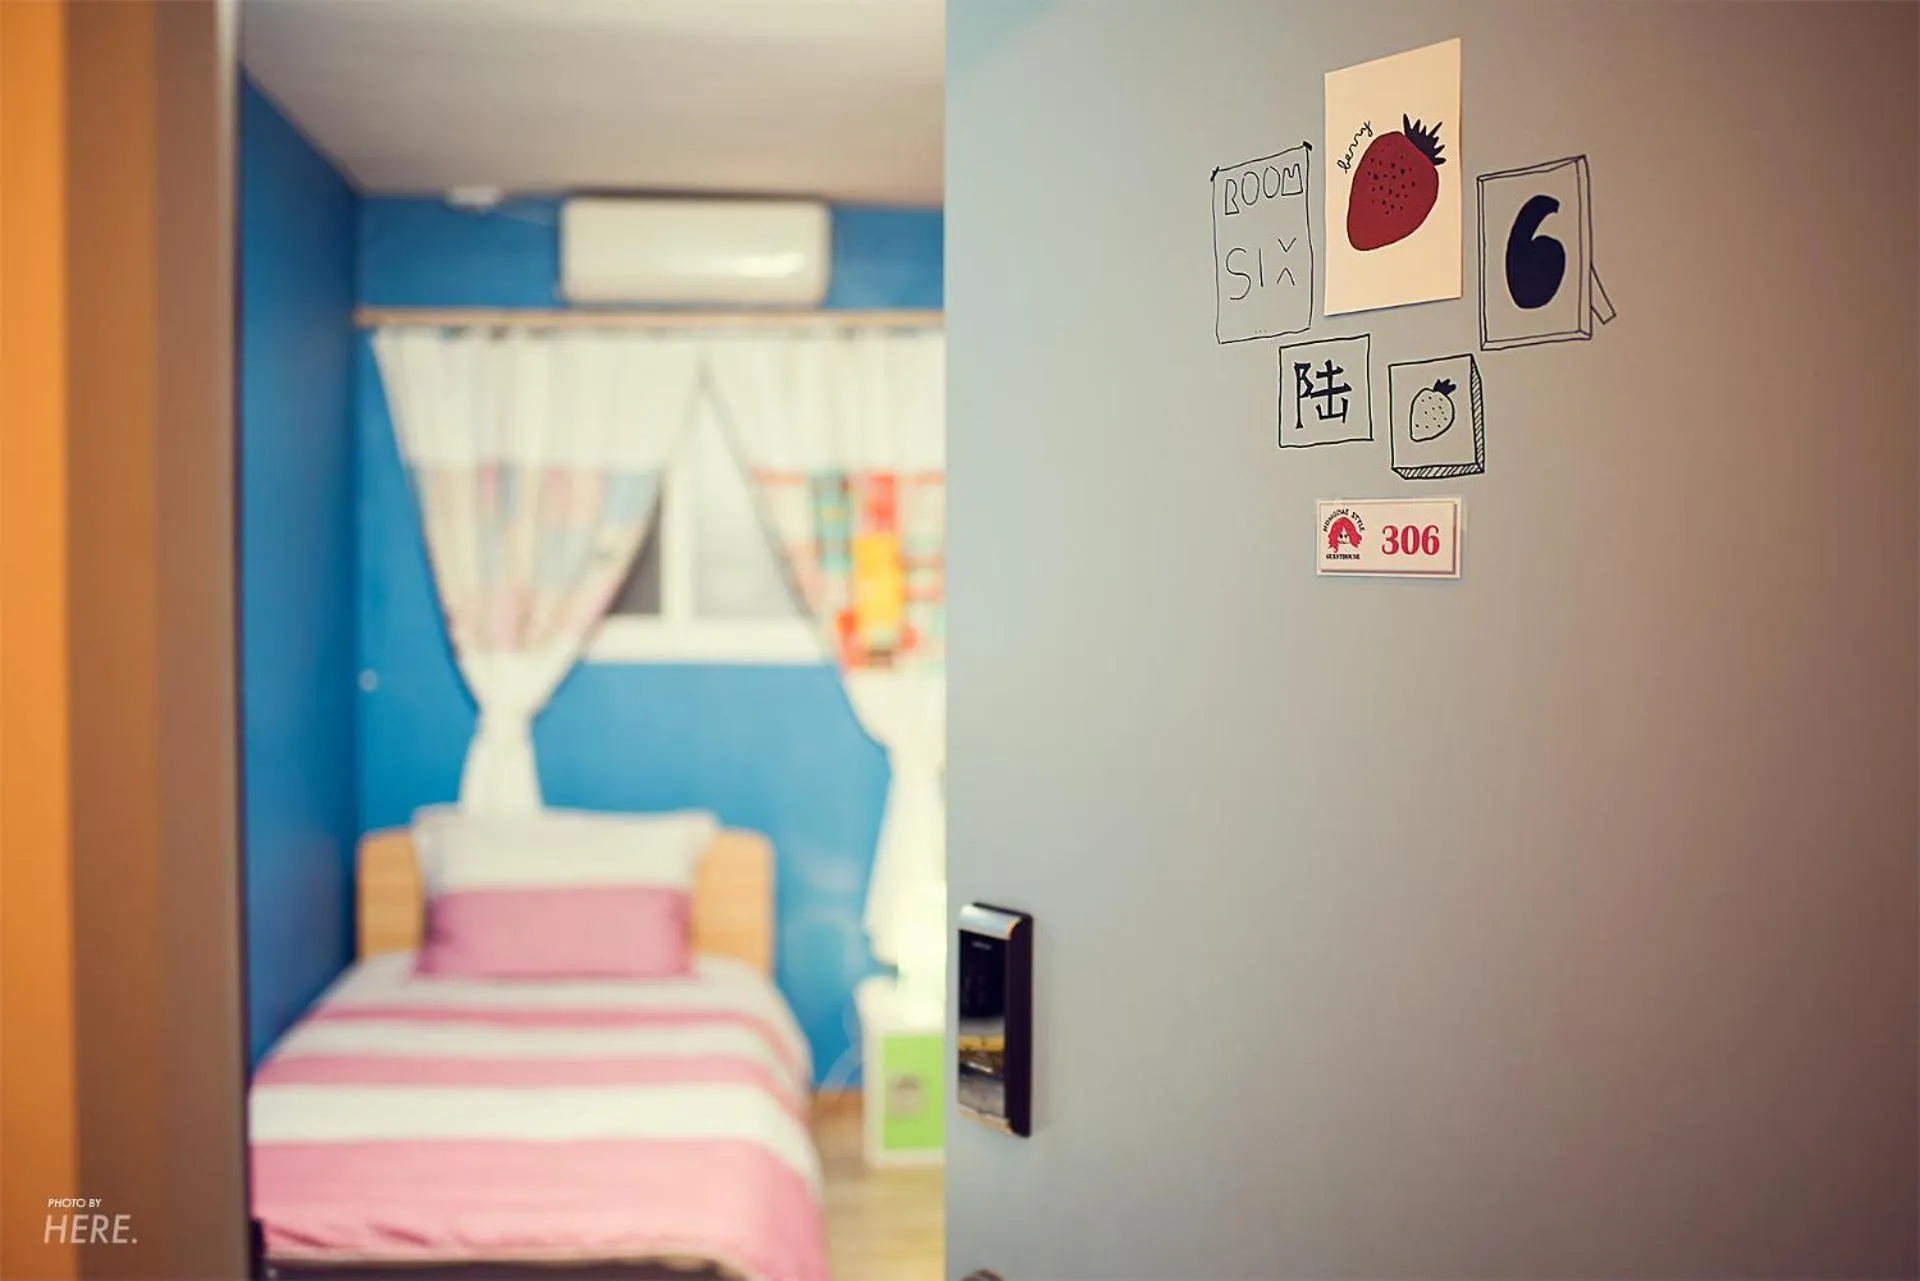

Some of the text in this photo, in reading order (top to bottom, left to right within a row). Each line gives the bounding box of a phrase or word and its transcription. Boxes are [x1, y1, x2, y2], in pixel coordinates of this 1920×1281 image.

[1336, 120, 1373, 174] berry
[1224, 163, 1304, 215] ROOM
[1225, 236, 1297, 300] SIX
[1505, 194, 1566, 309] 6
[1293, 359, 1353, 430] 陆
[1351, 511, 1366, 532] STYLE
[1380, 524, 1441, 556] 306
